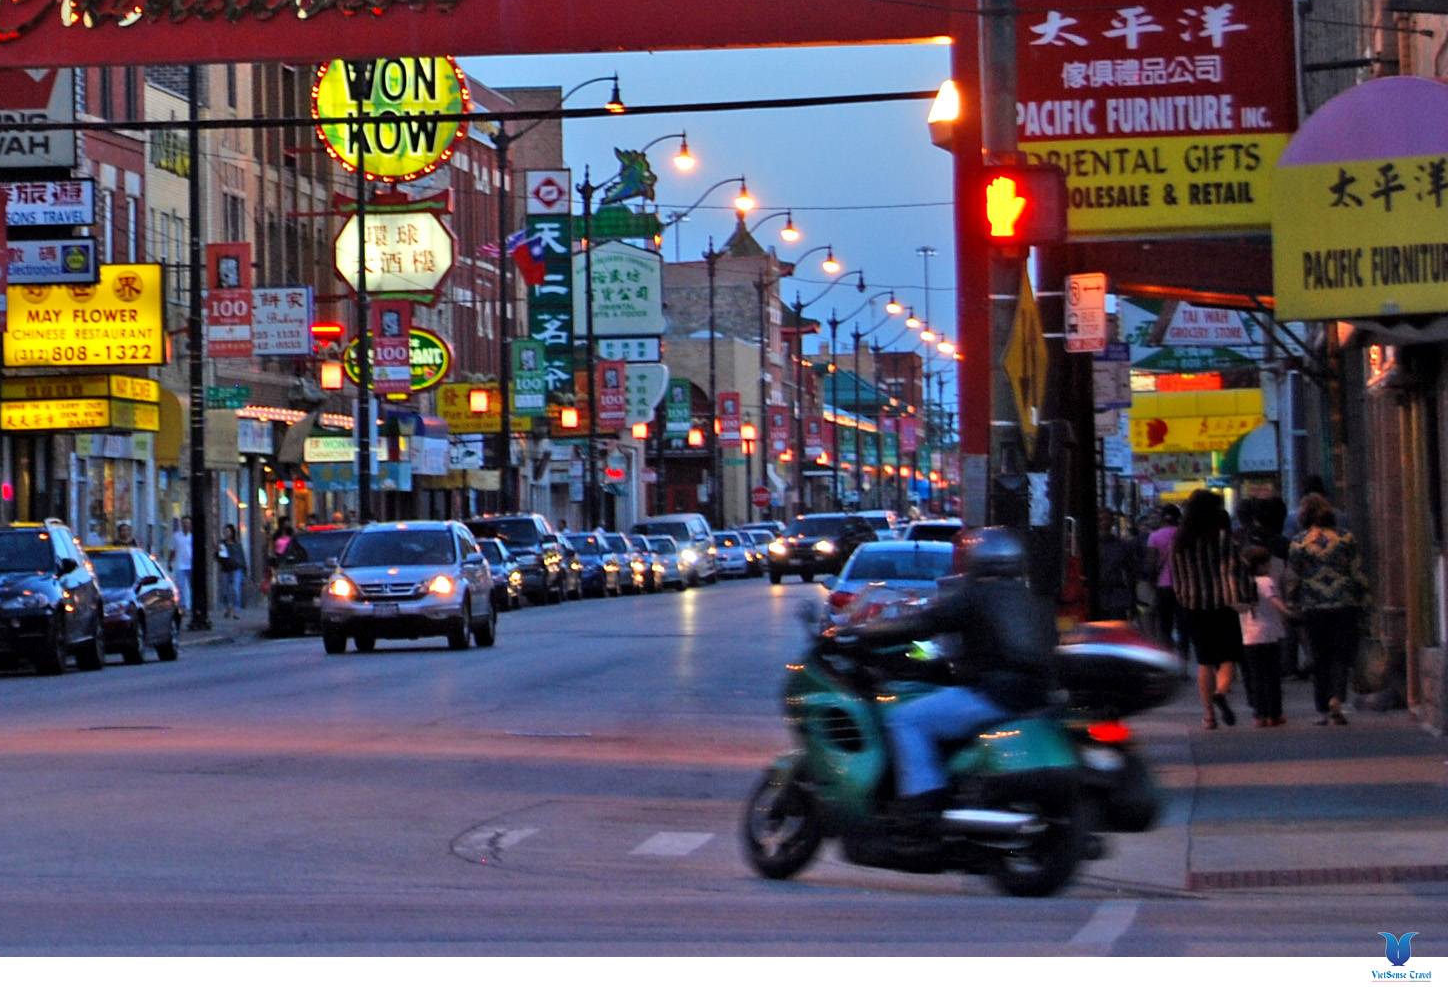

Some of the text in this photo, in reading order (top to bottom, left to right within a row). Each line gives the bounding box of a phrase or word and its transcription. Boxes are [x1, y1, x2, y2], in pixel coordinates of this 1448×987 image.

[1029, 3, 1249, 49] 太平洋
[343, 58, 436, 101] WON
[1016, 95, 1272, 136] PACIFIC FURNITURE INC.
[348, 110, 440, 154] KOW
[1185, 143, 1261, 174] GIFTS
[1163, 183, 1177, 206] &
[1189, 182, 1255, 206] RETAIL
[39, 210, 85, 224] TRAVEL
[1303, 247, 1363, 290] PACIFIC
[27, 309, 138, 323] MAY FLOWER
[212, 300, 247, 317] 100
[11, 328, 152, 341] CHINESE RESTAURANT
[376, 347, 407, 361] 100
[516, 379, 542, 390] 100
[601, 396, 624, 405] 100
